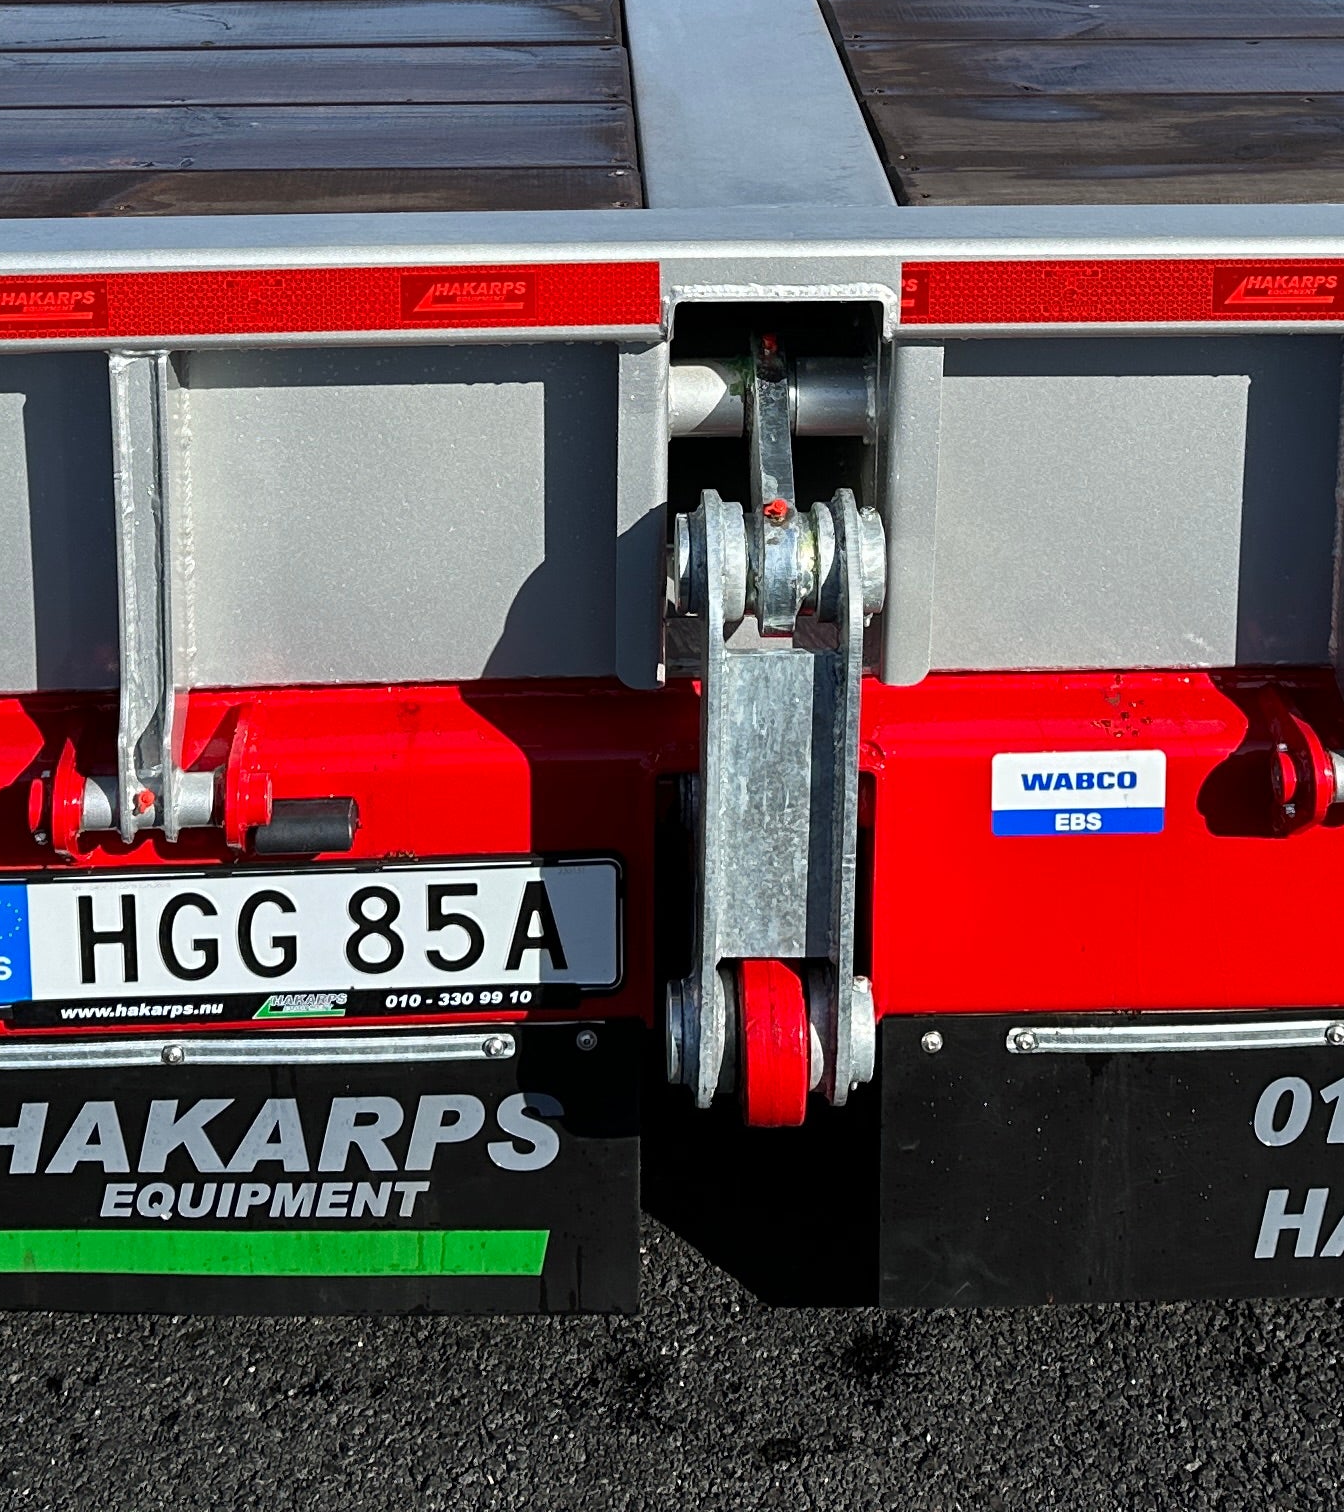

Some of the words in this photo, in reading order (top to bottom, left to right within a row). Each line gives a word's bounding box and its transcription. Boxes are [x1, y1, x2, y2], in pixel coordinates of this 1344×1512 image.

[434, 281, 527, 296] HAKARPS
[1246, 275, 1338, 289] HAKARPS
[0, 290, 96, 305] HAKARPS
[1021, 771, 1138, 791] WABCO
[1054, 812, 1103, 832] EBS
[76, 888, 298, 985] HGG
[344, 878, 569, 975] 85A
[271, 992, 348, 1007] HAKARPS
[385, 994, 421, 1009] 010
[438, 992, 476, 1007] 330
[479, 991, 504, 1005] 99
[508, 990, 532, 1004] 10
[60, 1000, 223, 1020] www.hakarps.nu
[99, 1180, 430, 1220] EQUIPMENT
